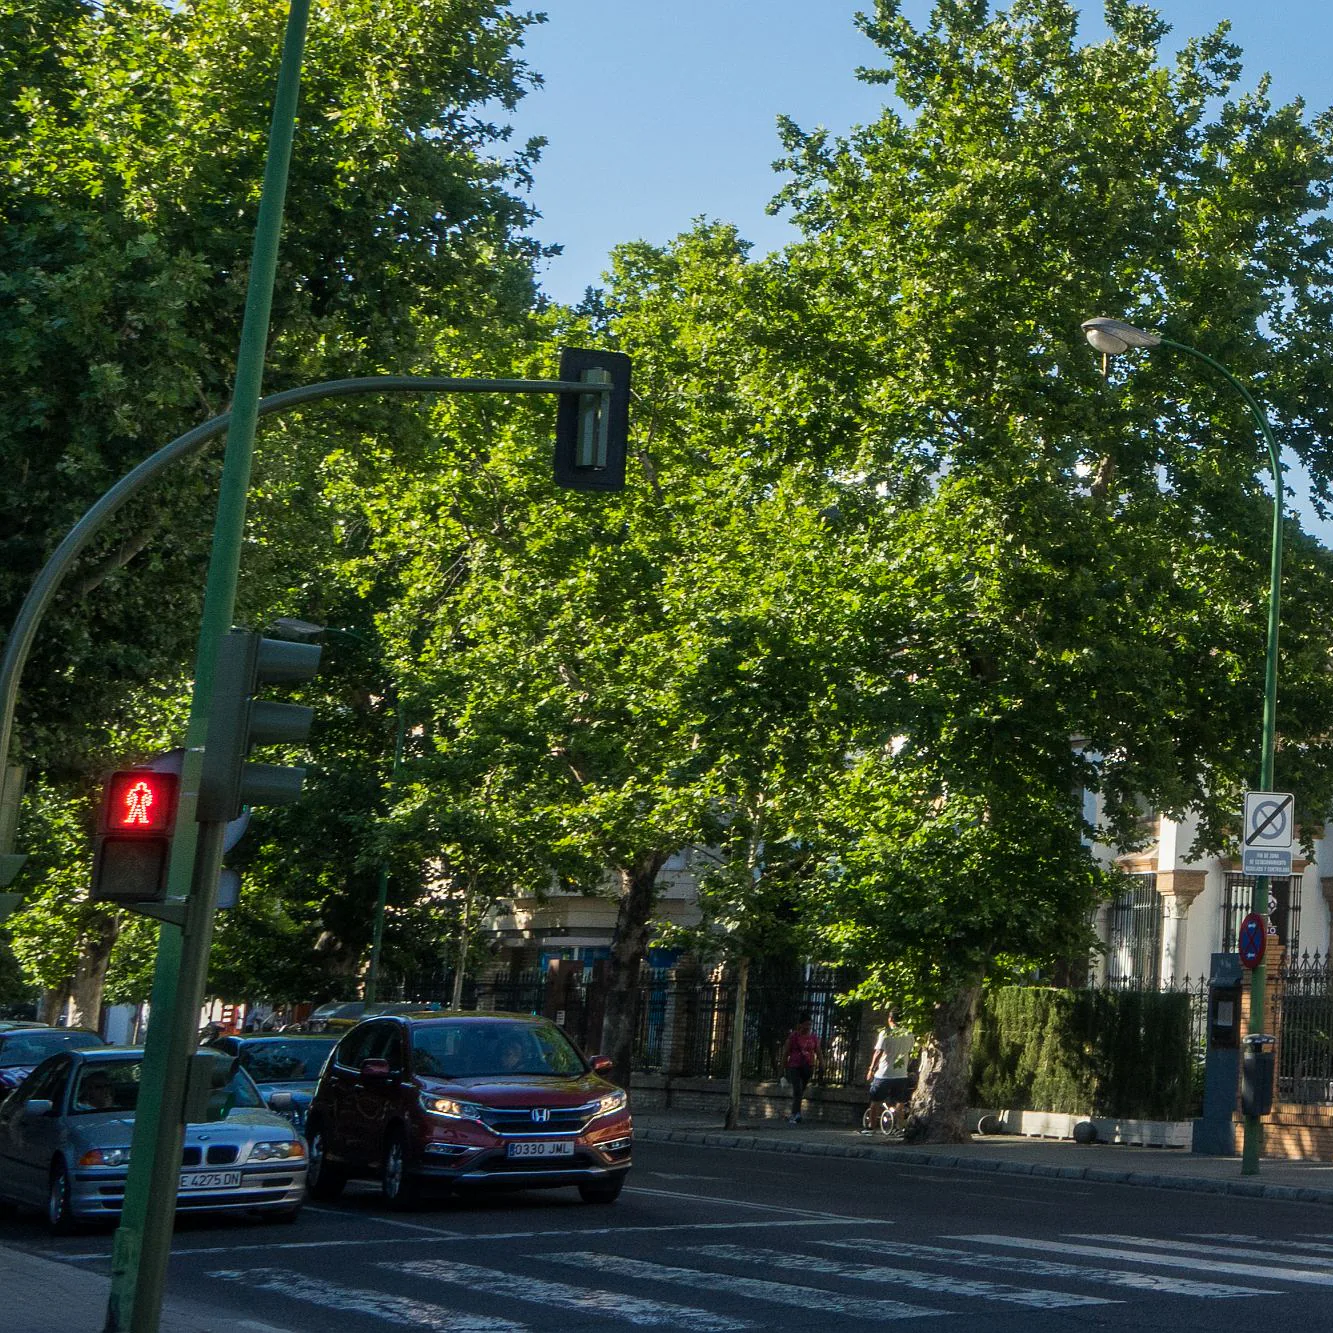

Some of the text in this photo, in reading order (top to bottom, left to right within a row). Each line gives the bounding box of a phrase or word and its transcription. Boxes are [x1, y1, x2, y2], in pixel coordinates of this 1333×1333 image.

[515, 1142, 570, 1155] 0330 JML
[191, 1174, 221, 1187] 4275
[224, 1173, 240, 1186] DN
